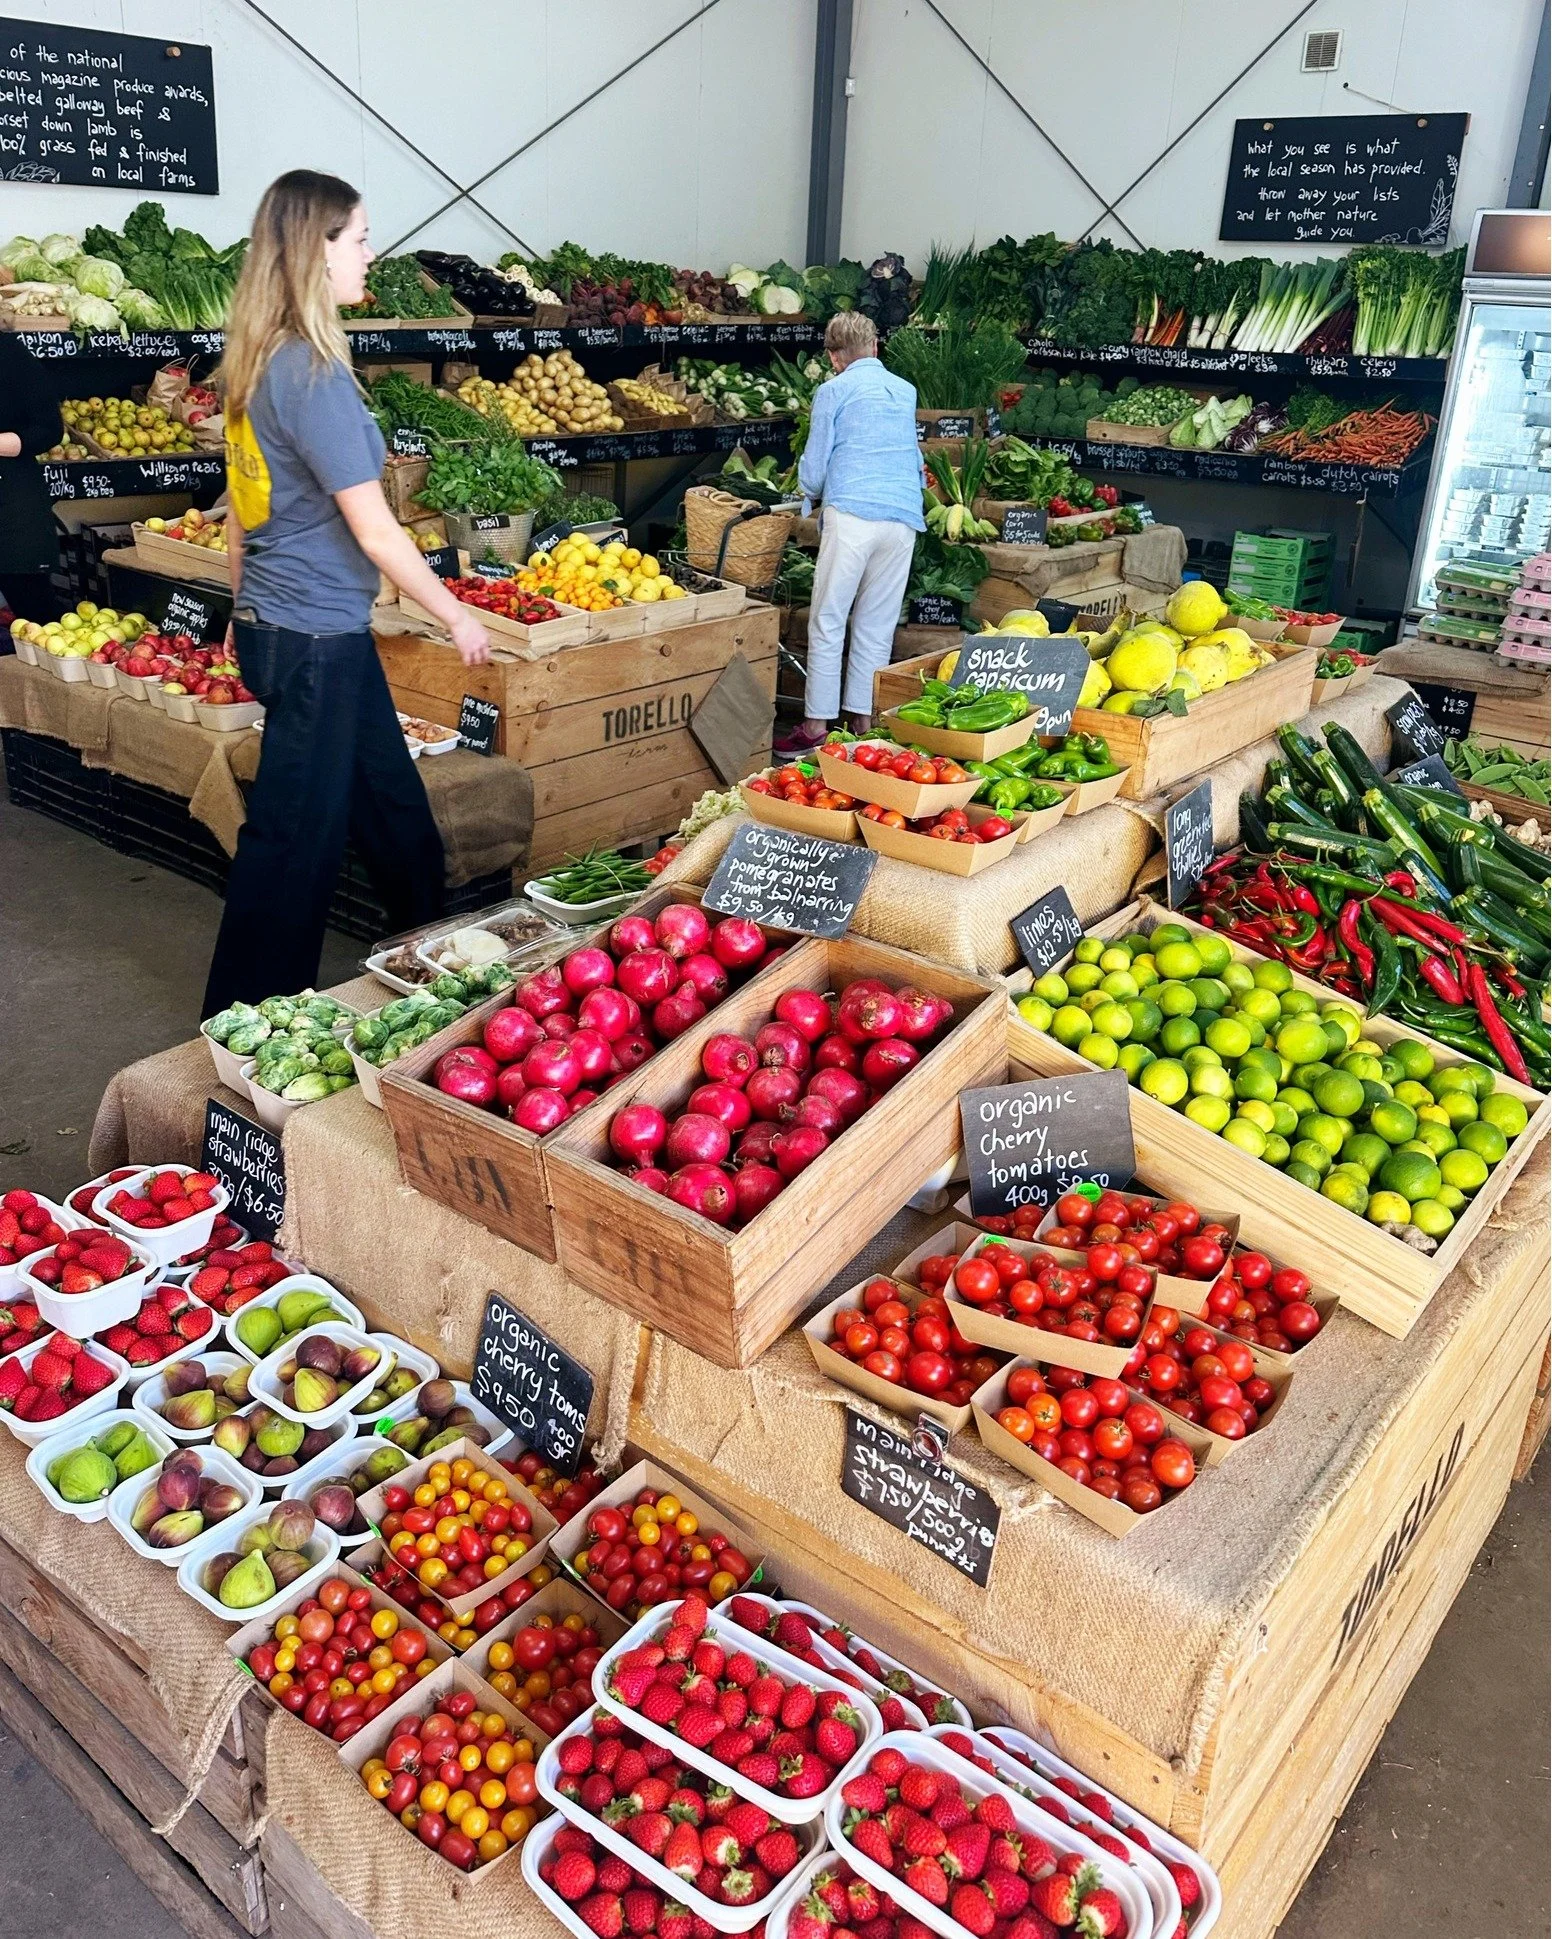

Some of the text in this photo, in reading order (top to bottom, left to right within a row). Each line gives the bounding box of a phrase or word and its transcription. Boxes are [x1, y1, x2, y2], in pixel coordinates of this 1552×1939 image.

[10, 43, 123, 72] of the national
[41, 71, 100, 90] magazine
[113, 79, 155, 96] produce
[165, 85, 209, 107] awards,
[55, 94, 105, 117] galloway
[116, 99, 144, 120] beef
[158, 107, 171, 121] &
[41, 115, 73, 133] down
[87, 118, 117, 136] lamb
[130, 125, 143, 140] is
[40, 139, 76, 156] grass
[88, 140, 107, 160] fed
[119, 146, 130, 159] &
[136, 143, 187, 165] finished
[1248, 138, 1400, 159] what you see is what
[92, 163, 196, 187] on local farms
[1243, 159, 1426, 183] the local season has provided.
[1258, 186, 1400, 206] throw away your lists
[1237, 206, 1379, 222] and let mother nature
[1294, 226, 1323, 240] guide
[132, 333, 176, 347] lettuce
[1163, 348, 1188, 360] chard
[1248, 352, 1274, 366] leeks
[1305, 357, 1348, 369] rhubarb
[1360, 358, 1396, 371] celery
[1365, 368, 1391, 377] $2.50
[1116, 447, 1147, 462] sprouts
[43, 463, 68, 483] fuji
[140, 462, 190, 477] William
[1262, 472, 1297, 484] carrots
[1321, 465, 1399, 488] dutch carrots
[476, 516, 500, 529] basil
[1008, 511, 1037, 521] organic
[914, 596, 939, 607] organic
[168, 603, 208, 628] organic apples
[967, 642, 1033, 670] snack
[965, 669, 1066, 696] capsicum
[602, 692, 692, 743] TORELLO
[1174, 808, 1192, 837] long
[745, 831, 830, 867] organically
[728, 857, 838, 892] pomegranates
[763, 852, 810, 872] grown
[730, 875, 854, 923] from balnarring
[1020, 905, 1056, 948] limes
[980, 1086, 1077, 1128] organic
[210, 1112, 278, 1166] main ridge
[980, 1125, 1049, 1156] cherry
[208, 1132, 284, 1195] strawberries
[987, 1148, 1089, 1188] tomatoes
[1004, 1171, 1109, 1207] 400g $950
[491, 1304, 560, 1372] organic
[484, 1335, 587, 1433] cherry toms
[476, 1362, 575, 1448] $9.50 400
[856, 1418, 911, 1460] main
[907, 1521, 978, 1573] punnets
